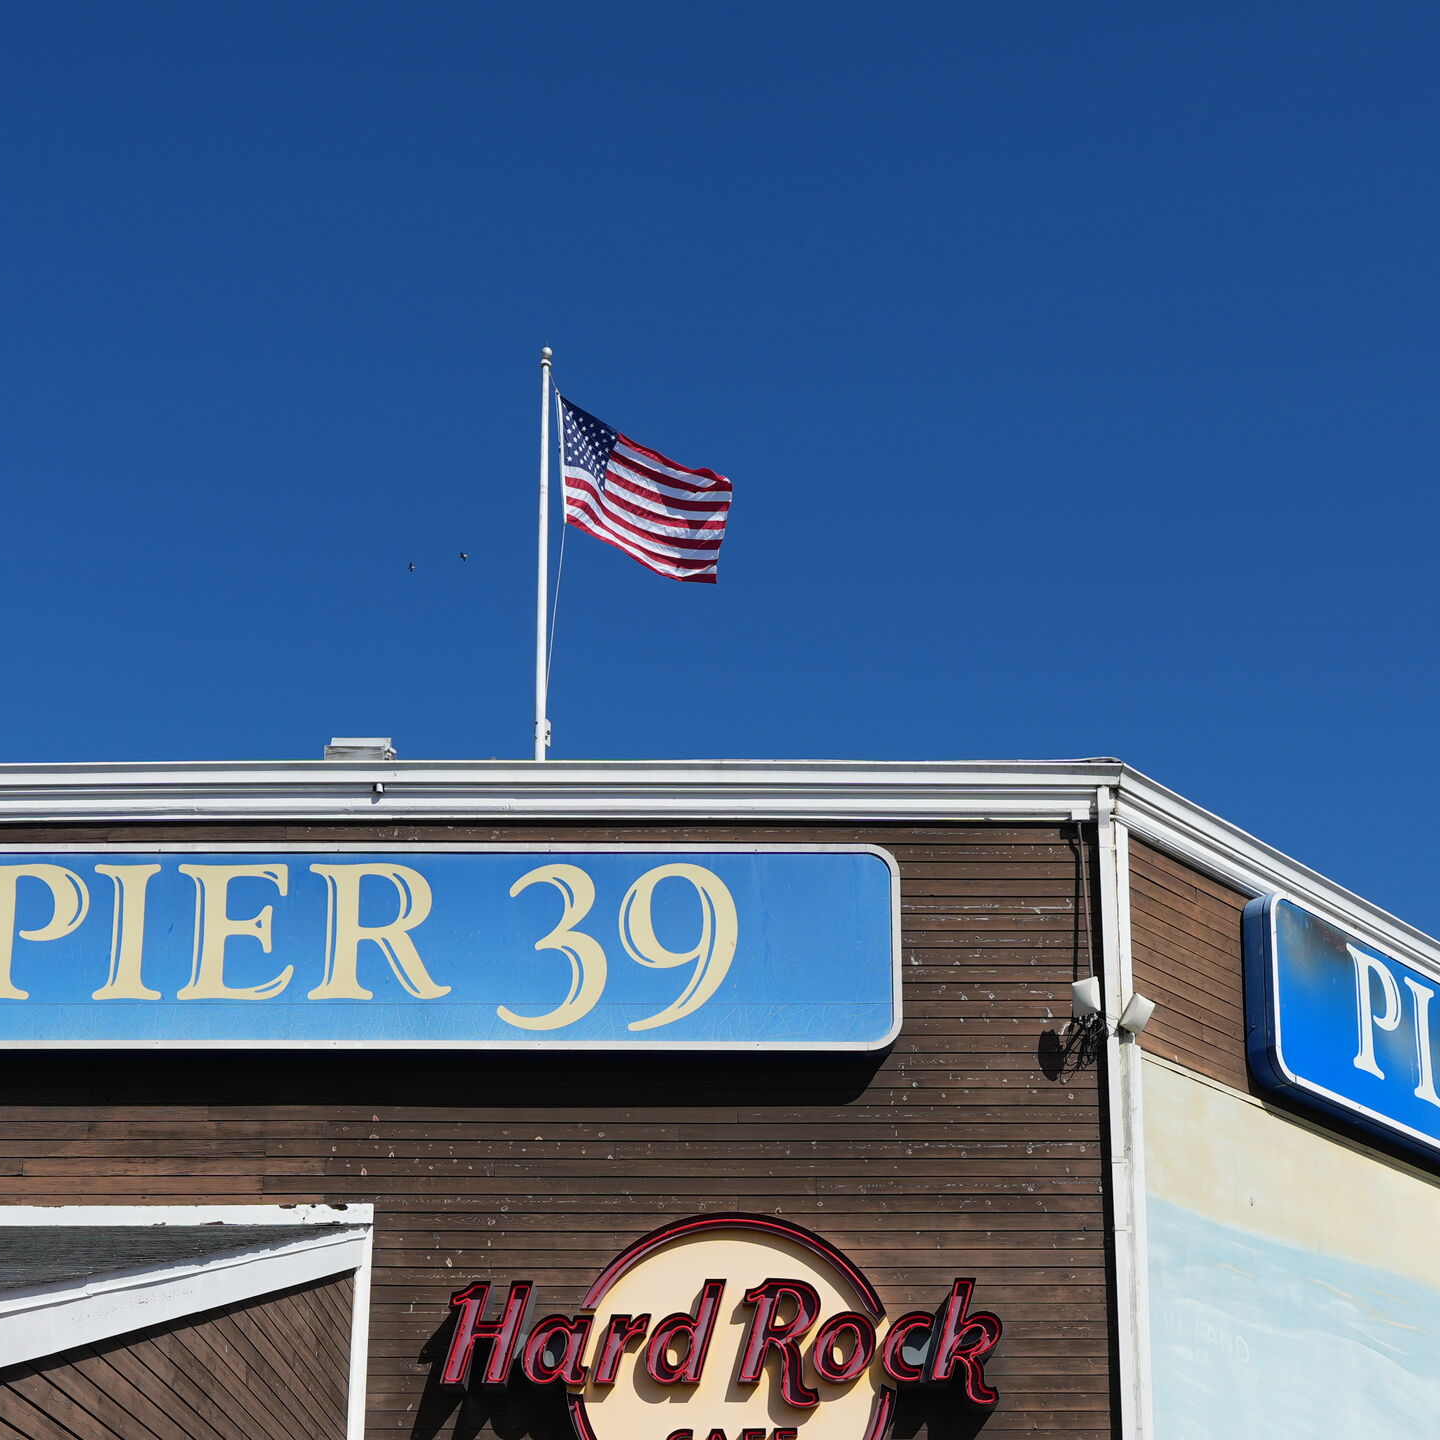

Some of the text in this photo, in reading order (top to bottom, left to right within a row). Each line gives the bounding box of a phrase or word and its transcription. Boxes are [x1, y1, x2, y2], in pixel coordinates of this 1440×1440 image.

[496, 863, 738, 1031] 39
[440, 1277, 1003, 1410] Hard Rock
